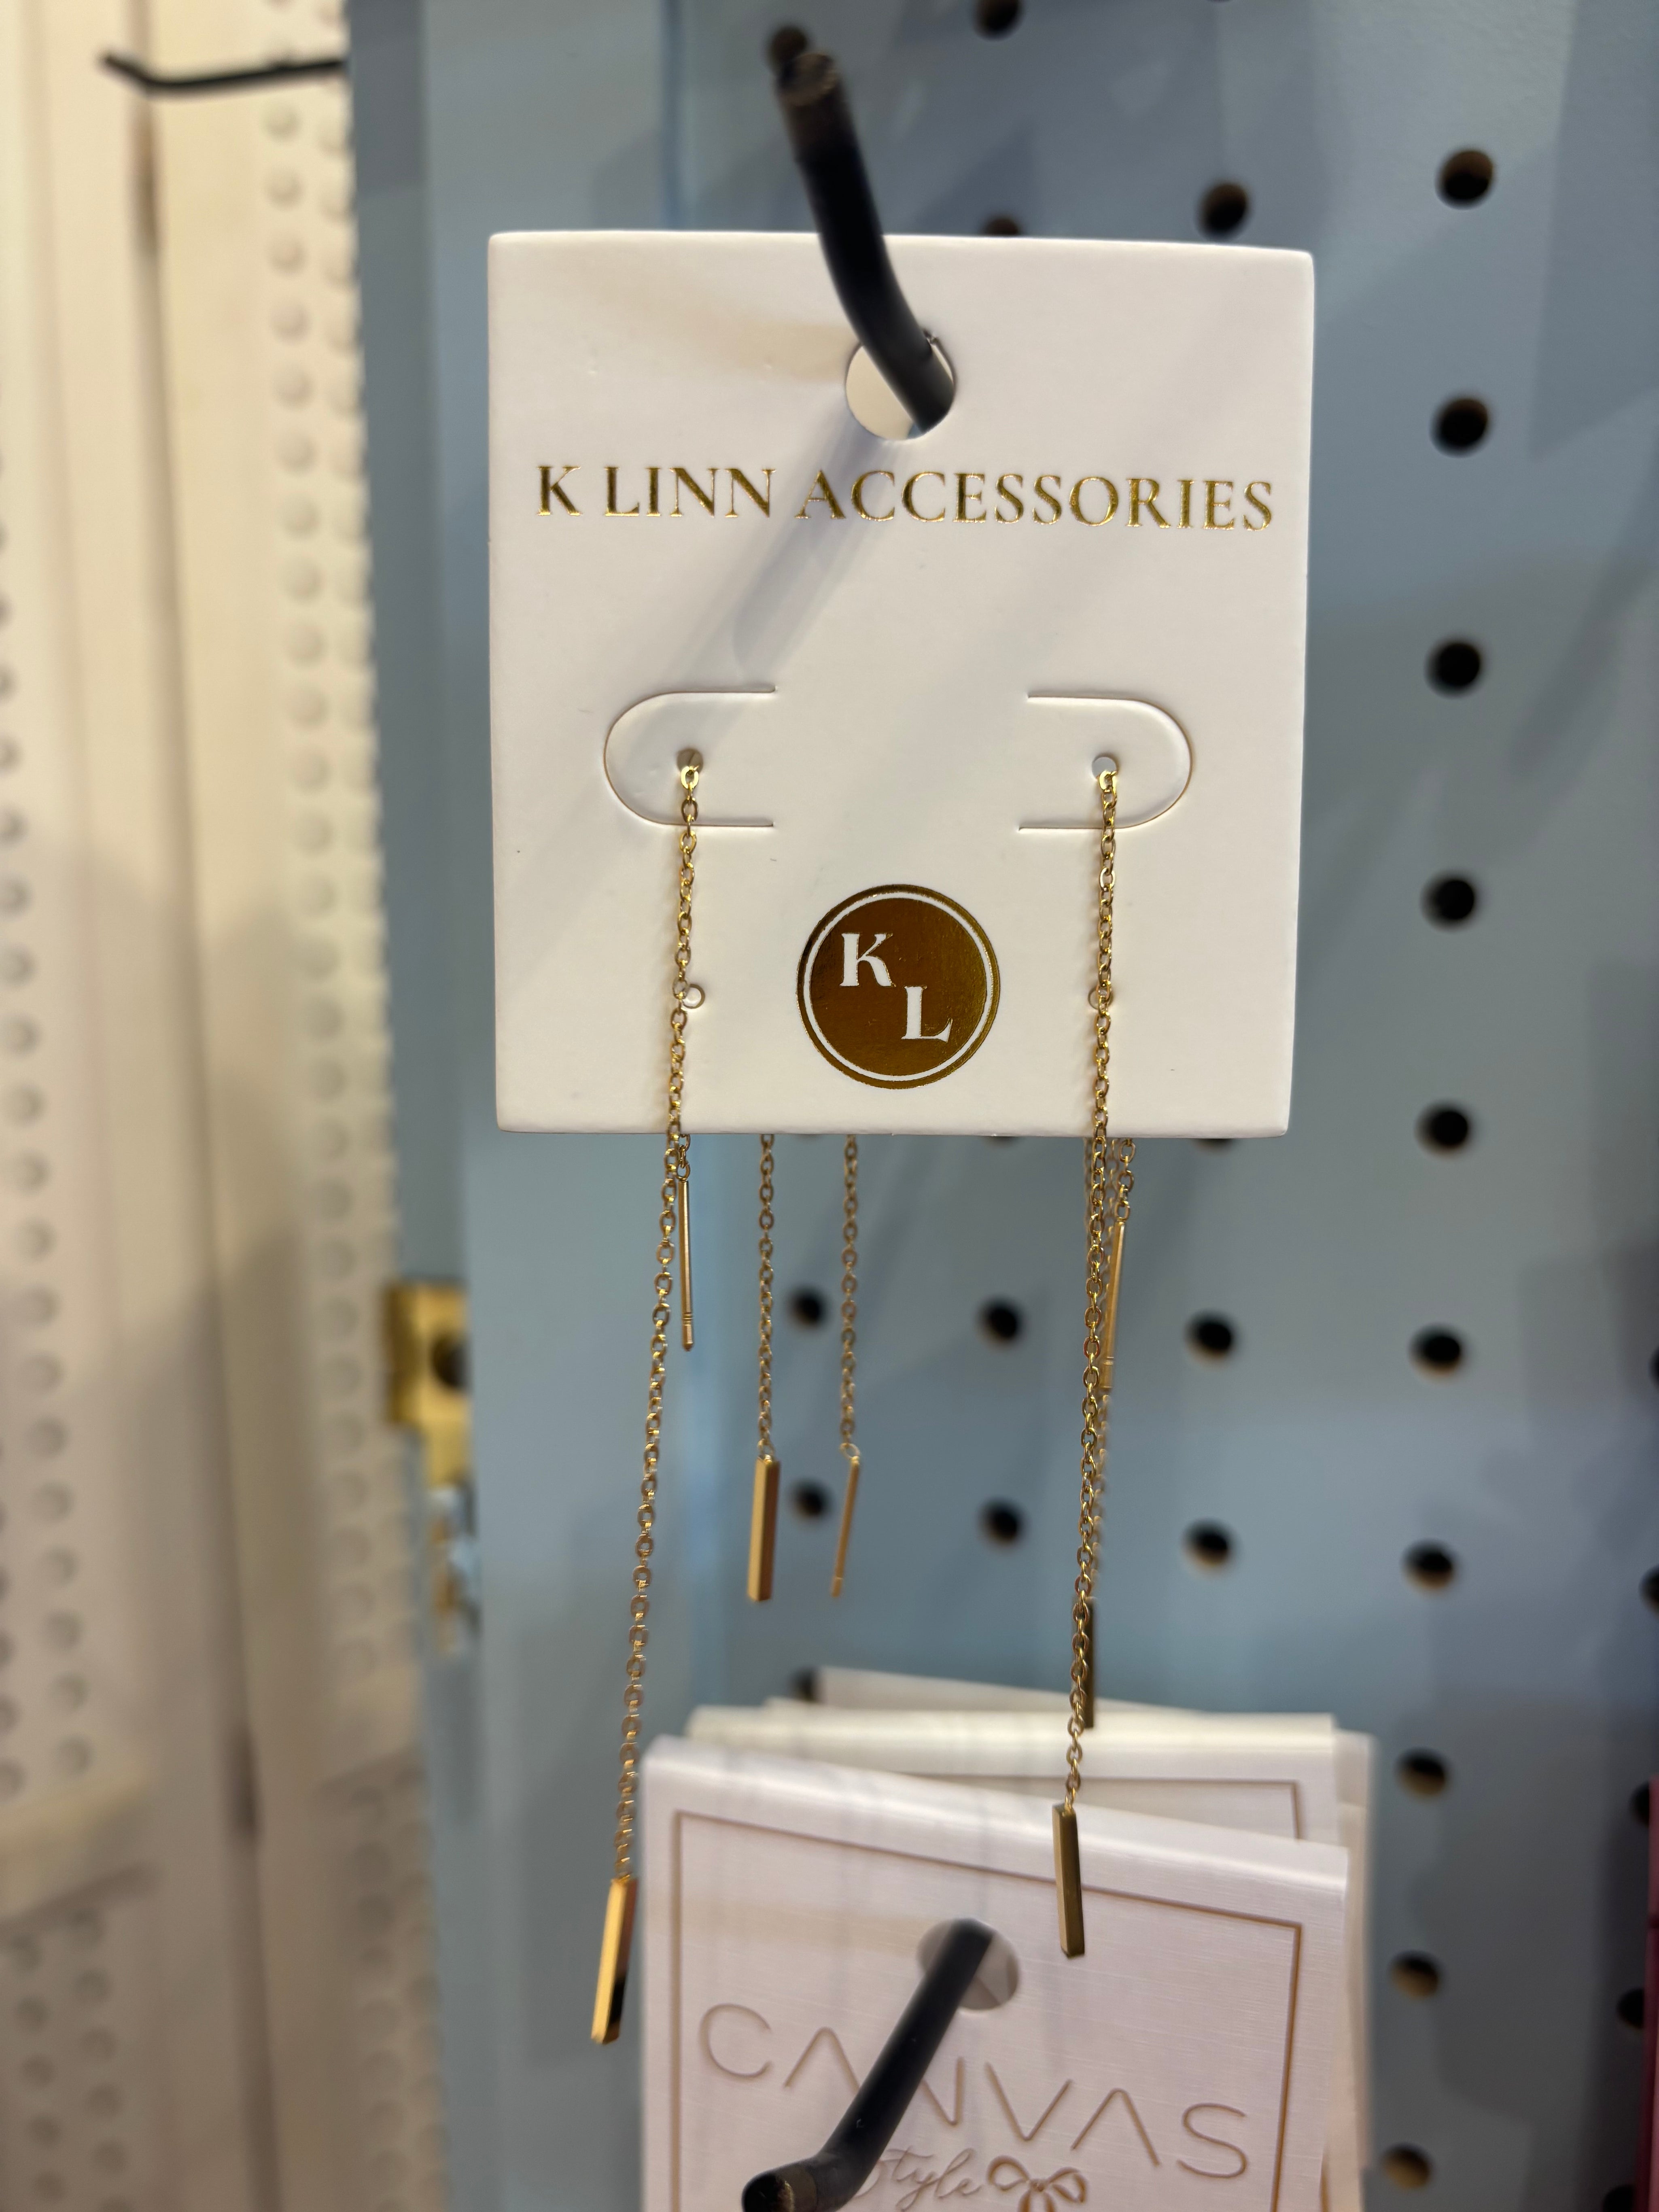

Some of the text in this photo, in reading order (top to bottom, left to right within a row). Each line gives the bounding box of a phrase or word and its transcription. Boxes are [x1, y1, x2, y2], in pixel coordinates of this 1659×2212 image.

[537, 466, 1273, 531] K LINN ACCESSORIES
